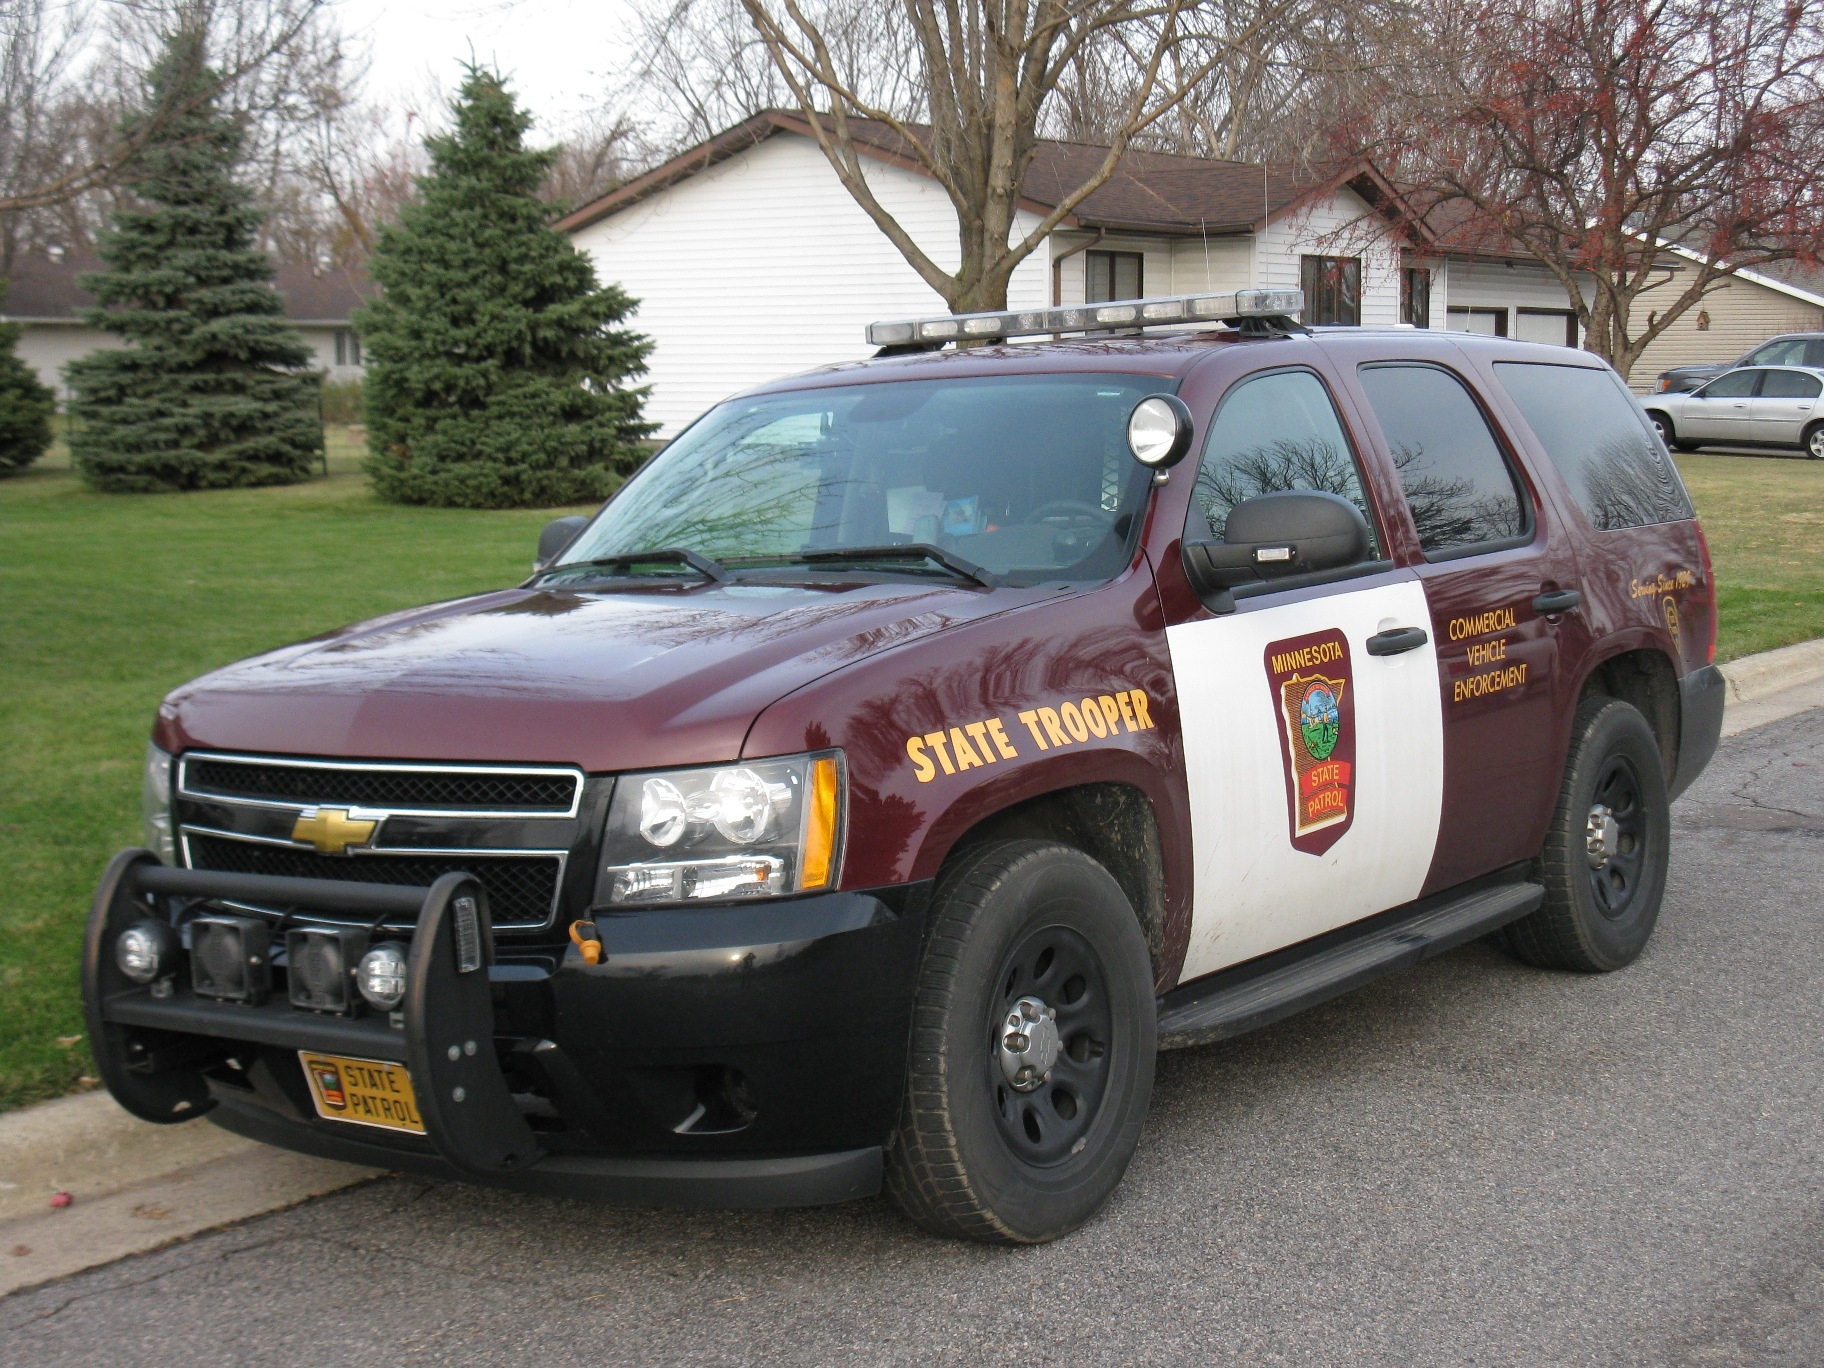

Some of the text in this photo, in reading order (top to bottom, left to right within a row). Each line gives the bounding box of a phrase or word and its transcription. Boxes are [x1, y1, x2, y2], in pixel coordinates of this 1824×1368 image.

[1449, 608, 1515, 641] COMMERCIAL
[1272, 641, 1343, 674] MINNESOTA
[1467, 639, 1506, 667] VEHICLE
[1454, 664, 1527, 702] ENFORCEMENT
[906, 689, 1155, 783] STATE TROOPER
[1312, 765, 1339, 786] STATE
[1308, 791, 1343, 817] PATROL
[345, 1066, 401, 1093] STATE
[350, 1093, 419, 1124] PATROL
